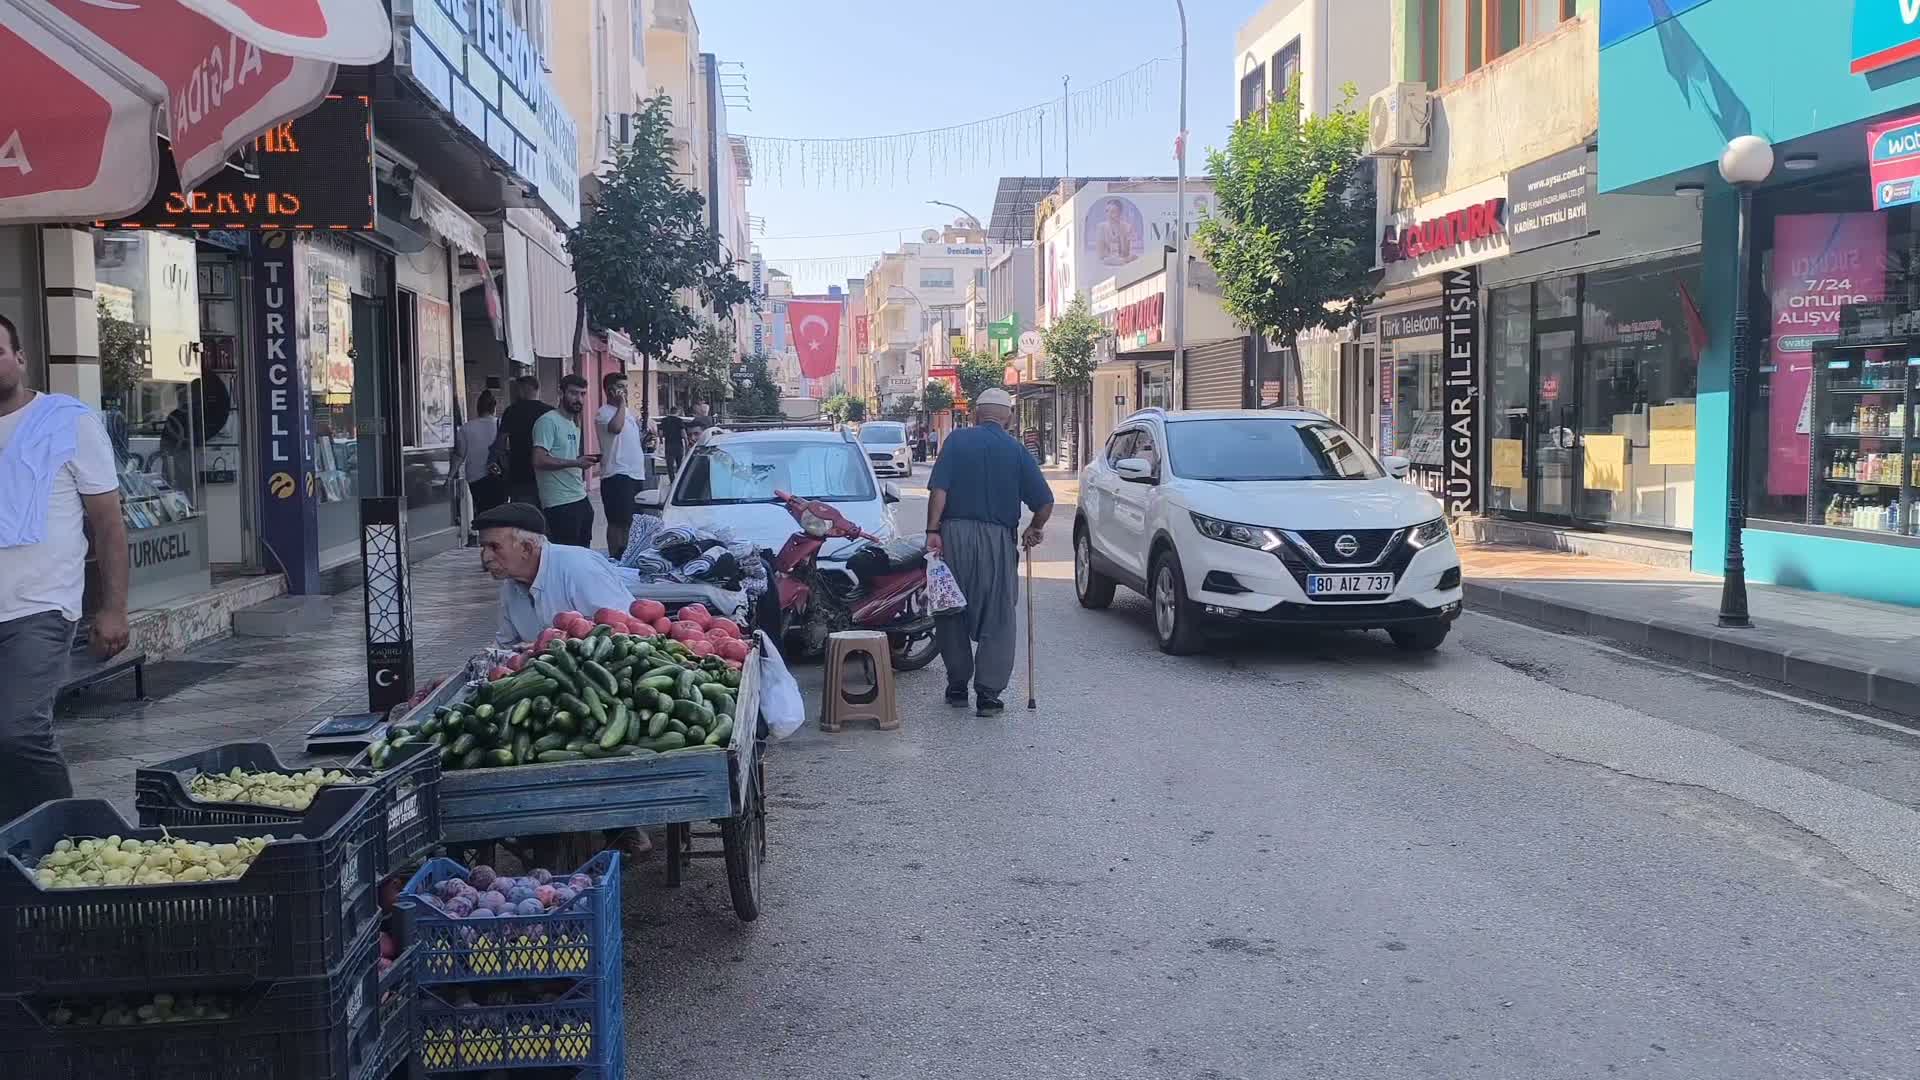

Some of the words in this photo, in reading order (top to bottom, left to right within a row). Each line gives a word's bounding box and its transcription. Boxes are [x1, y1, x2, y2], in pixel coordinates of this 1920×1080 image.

[1528, 165, 1586, 191] www.aysu.com.tr
[1805, 278, 1852, 292] 7/24
[1382, 319, 1400, 337] Türk
[1402, 314, 1440, 335] Telekom
[264, 261, 289, 461] TURKCELL
[1447, 398, 1472, 518] RÜZGAR
[1419, 465, 1444, 493] İLETİ
[1316, 577, 1333, 592] 80
[1340, 576, 1360, 591] AIZ
[1367, 576, 1391, 591] 737
